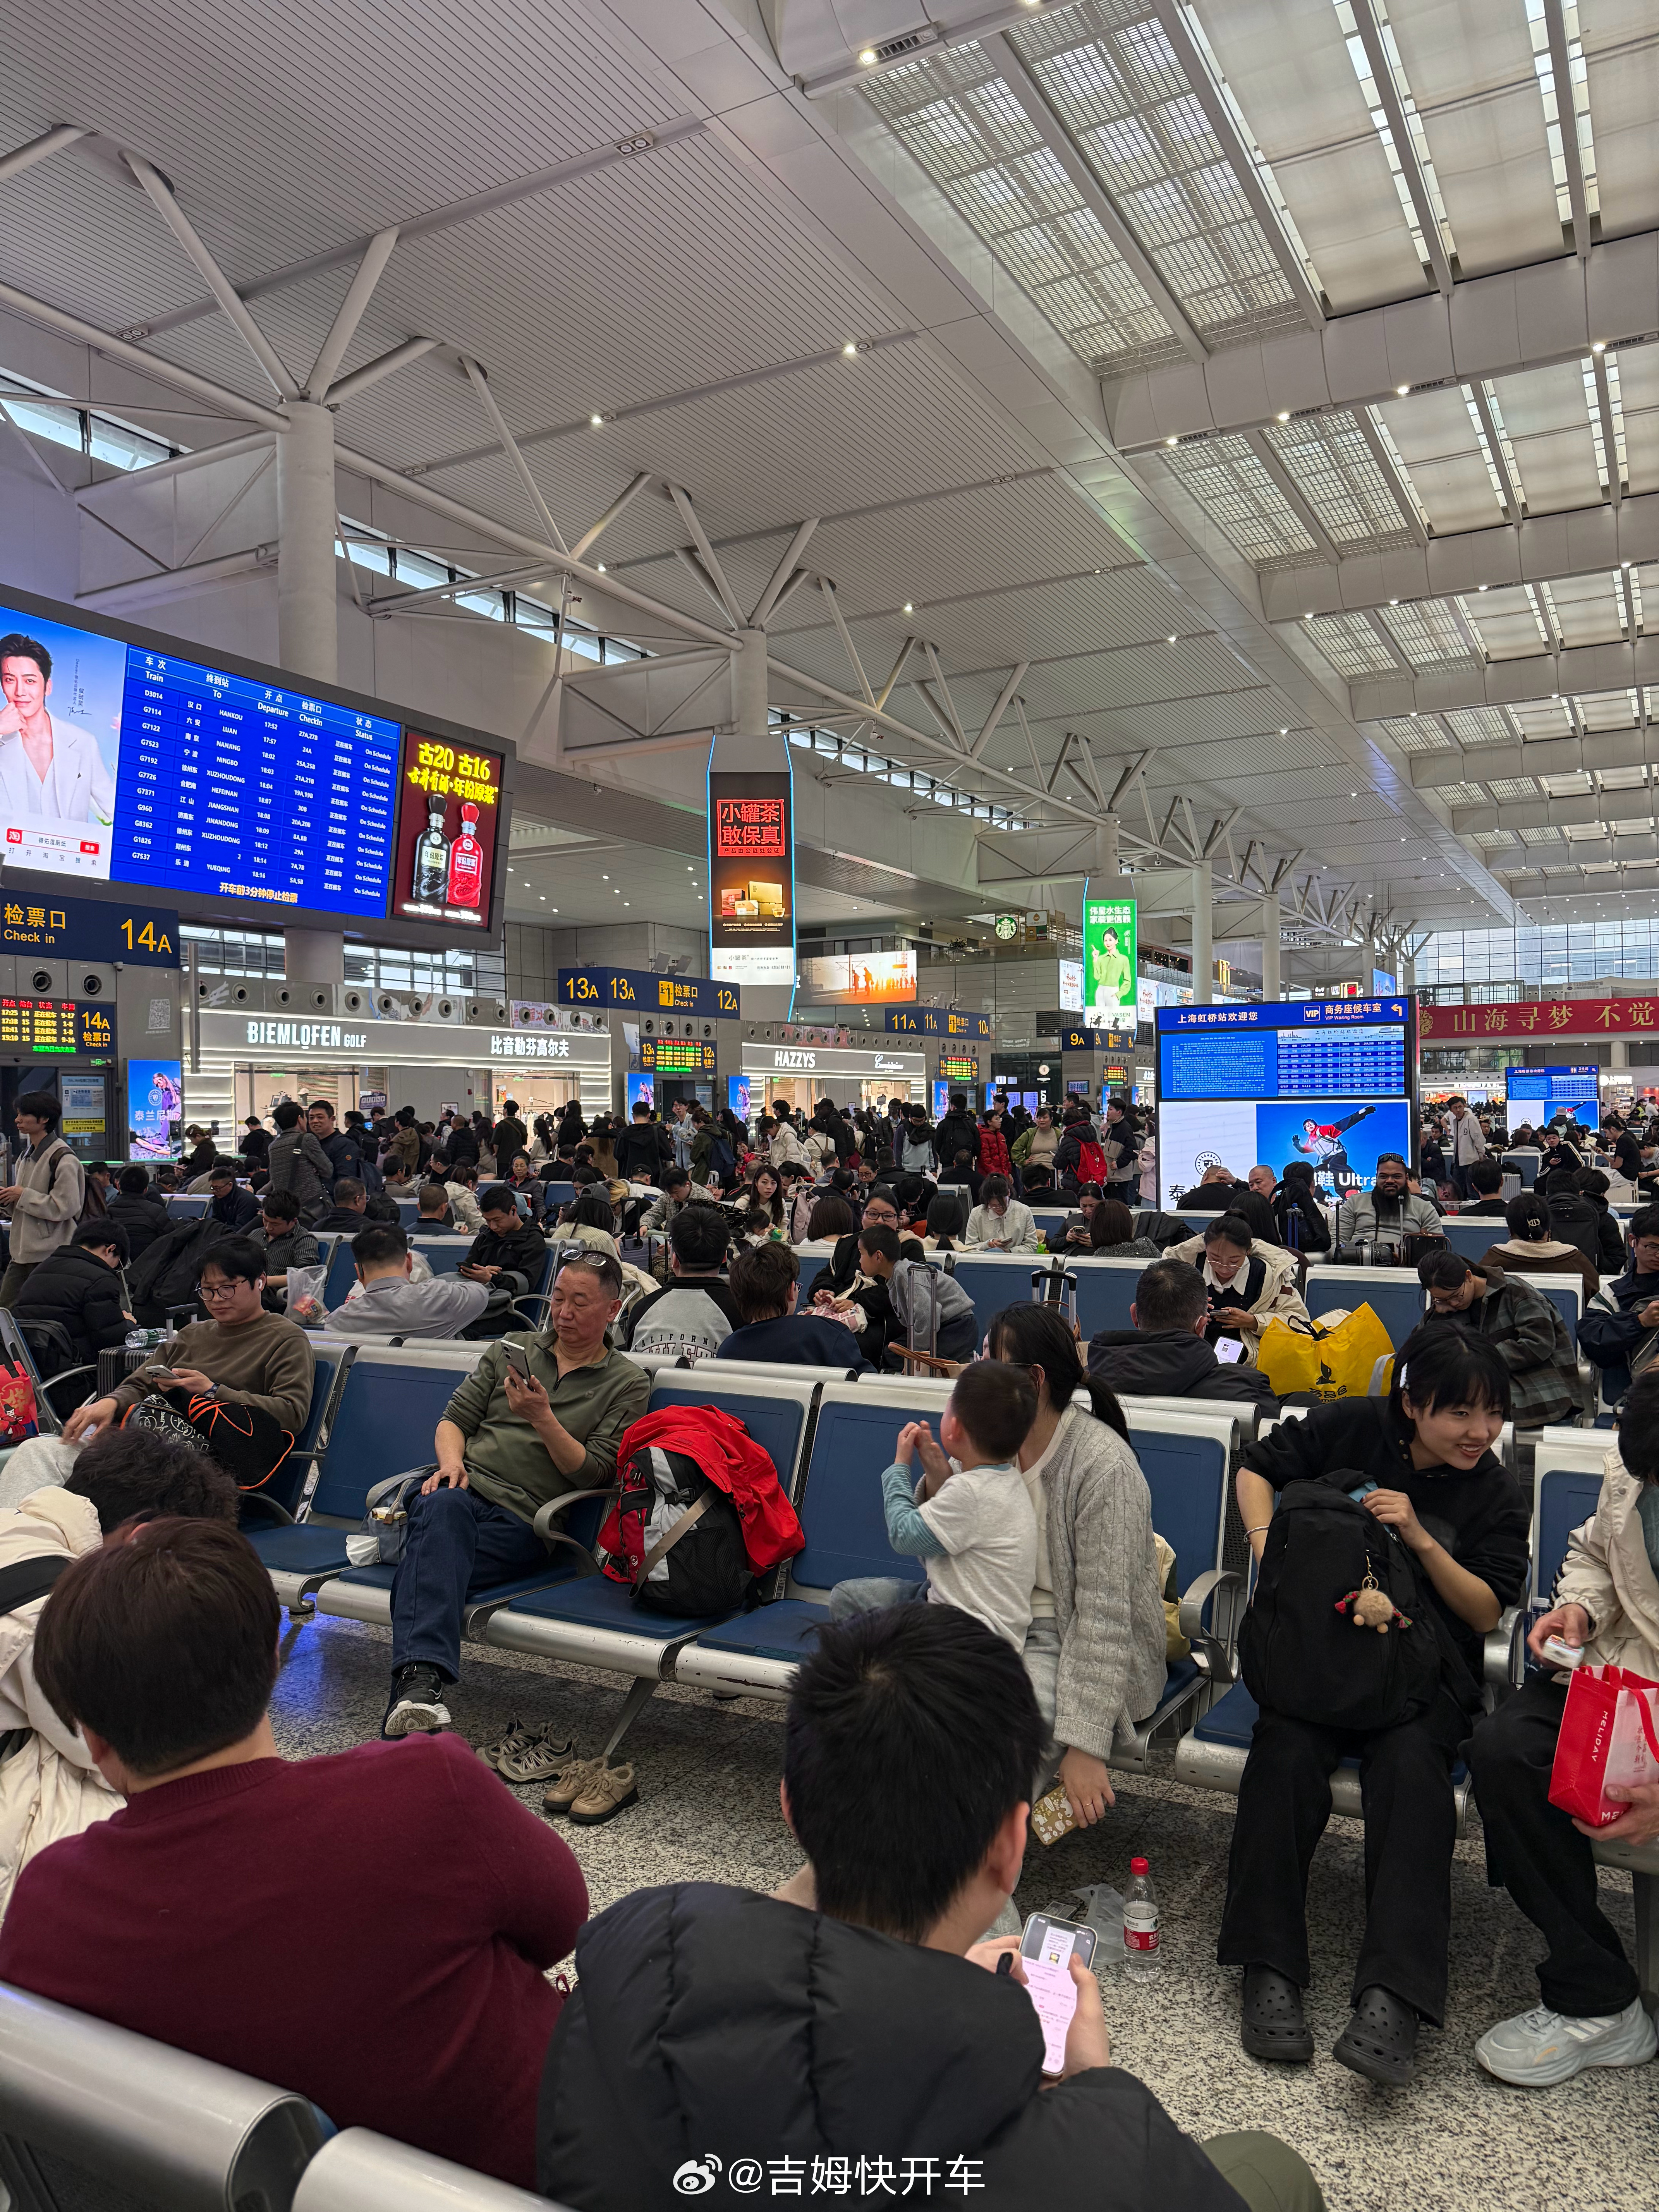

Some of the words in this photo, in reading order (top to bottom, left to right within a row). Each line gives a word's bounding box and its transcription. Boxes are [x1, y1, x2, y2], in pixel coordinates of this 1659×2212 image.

[145, 656, 166, 670] 车次
[206, 673, 229, 688] 终到站
[265, 690, 283, 703] 开点
[302, 701, 322, 714] 检票口
[356, 716, 372, 728] 状态
[145, 671, 163, 682] Train
[213, 689, 222, 698] To
[258, 702, 289, 717] Departure
[356, 730, 373, 740] Status
[145, 690, 163, 699] D3014
[187, 701, 202, 710] 汉口
[219, 709, 243, 721] HANKOU
[264, 721, 278, 730] 17:52
[299, 731, 318, 740] 27A,27B
[373, 750, 392, 761] Schedule
[143, 706, 161, 716] G7114
[186, 717, 201, 726] 六安
[222, 726, 237, 735] LUAN
[263, 737, 276, 745] 17:57
[371, 764, 390, 775] Schedule
[142, 722, 160, 732] G7122
[216, 740, 240, 751] NANJING
[262, 752, 275, 760] 18:02
[296, 760, 316, 770] 25A,25B
[370, 778, 389, 788] Schedule
[419, 742, 454, 771] 古20
[458, 754, 490, 780] 古16
[141, 739, 159, 748] G7523
[216, 756, 238, 766] NINGBO
[295, 775, 314, 784] 21A,21B
[369, 792, 388, 802] Schedule
[138, 771, 156, 780] G7726
[180, 780, 197, 789] 合肥南
[211, 787, 238, 797] HEFEINAN
[139, 755, 158, 764] G7192
[182, 764, 198, 773] 徐州东
[207, 769, 245, 784] XUZHOUDONG
[294, 790, 313, 799] 19A,19B
[368, 806, 387, 816] Schedule
[137, 788, 155, 796] G7371
[180, 796, 194, 805] 江山
[208, 802, 239, 813] JIANGSHAN
[291, 819, 311, 828] 20A,20B
[137, 804, 153, 812] G960
[206, 817, 238, 828] JINANDONG
[722, 803, 780, 823] 小罐茶
[8, 831, 20, 841] 淘
[133, 836, 151, 845] G1826
[134, 820, 153, 829] G8362
[201, 832, 240, 844] XUZHOUDONG
[722, 825, 780, 845] 敢保真
[132, 852, 150, 860] G7537
[207, 864, 230, 873] YUEQING
[219, 882, 298, 903] 开车前3分钟停止检票
[1090, 906, 1131, 915] 伟星水生态
[4, 903, 66, 929] 检票口
[121, 919, 172, 953] 14A
[4, 929, 40, 943] Check
[45, 933, 55, 944] in
[566, 977, 599, 999] 13A
[611, 977, 635, 1000] 13A
[675, 984, 698, 998] 检票口
[718, 989, 738, 1010] 12A
[1177, 1011, 1258, 1024] 上海虹桥站欢迎您
[1325, 1003, 1382, 1015] 商务座候车室
[1454, 1005, 1573, 1032] 山海寻梦
[1594, 1001, 1655, 1028] 不觉
[82, 1011, 110, 1029] 14A
[892, 1014, 916, 1030] 11A
[925, 1014, 937, 1030] 11A
[978, 1020, 989, 1034] 10A
[83, 1032, 110, 1042] 检票口
[247, 1021, 341, 1049] BIEMLOFEN
[343, 1034, 367, 1048] GOLF
[1070, 1033, 1085, 1045] 9A
[491, 1035, 569, 1057] 比音勒芬高尔夫
[642, 1043, 654, 1055] 13A
[703, 1046, 714, 1057] 12A
[775, 1051, 816, 1068] HAZZYS
[1314, 1170, 1334, 1187] 鞋
[1592, 1711, 1608, 1762] MELIDAY
[1601, 1811, 1624, 1822] ME
